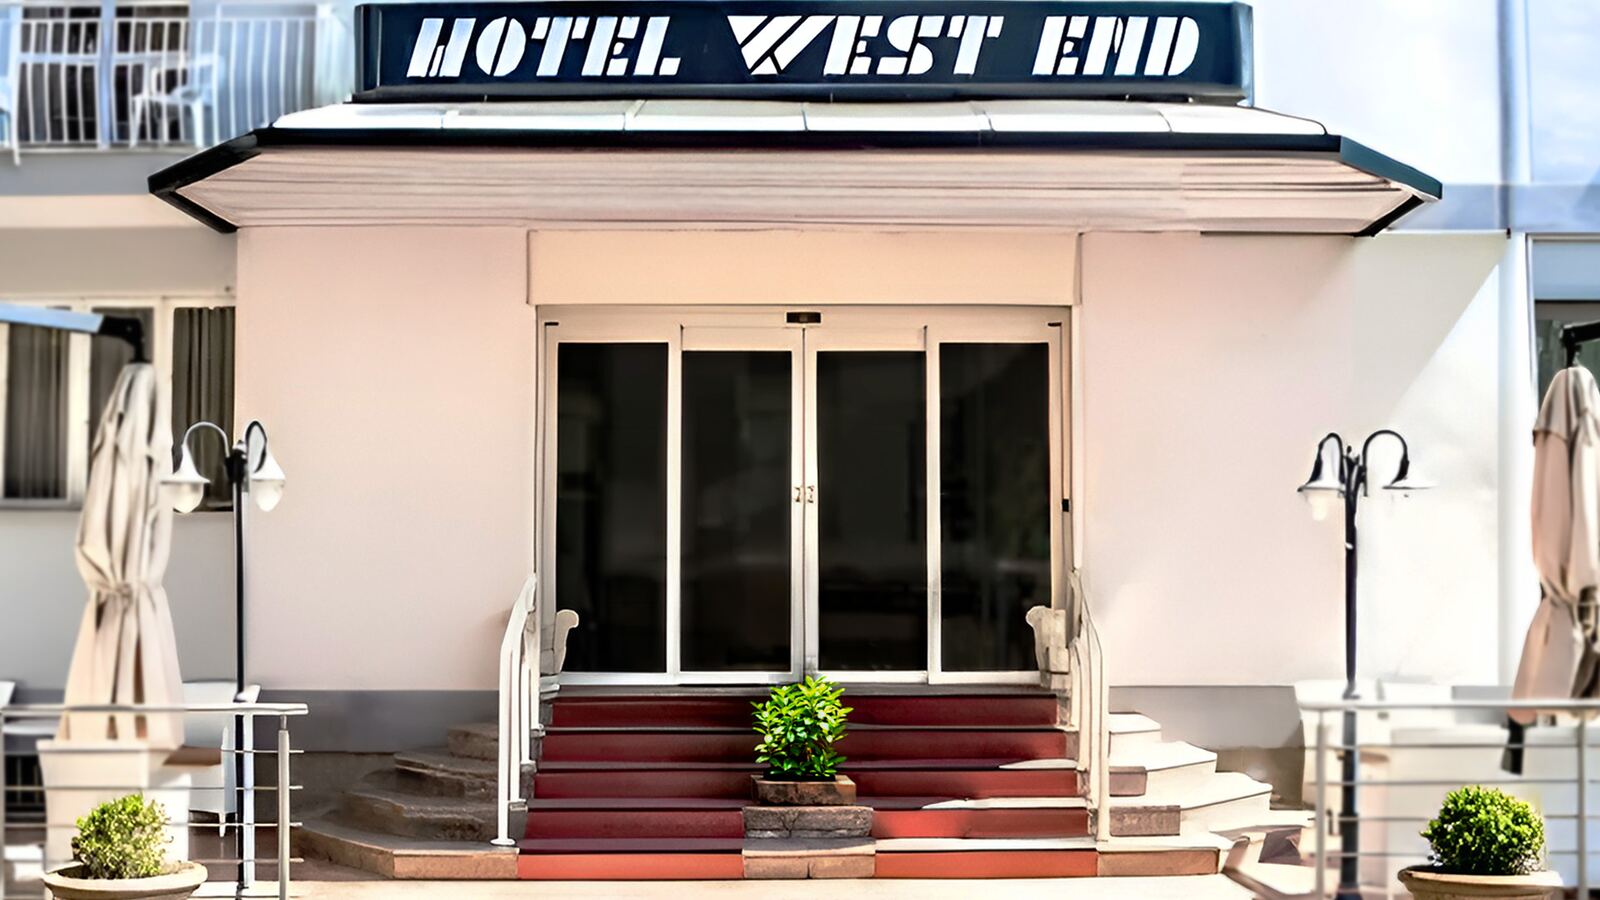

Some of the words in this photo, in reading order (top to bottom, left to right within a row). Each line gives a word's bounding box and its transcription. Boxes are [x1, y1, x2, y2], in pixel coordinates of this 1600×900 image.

[407, 16, 681, 77] HOTEL
[727, 15, 1005, 76] WEST
[1032, 16, 1200, 76] END
